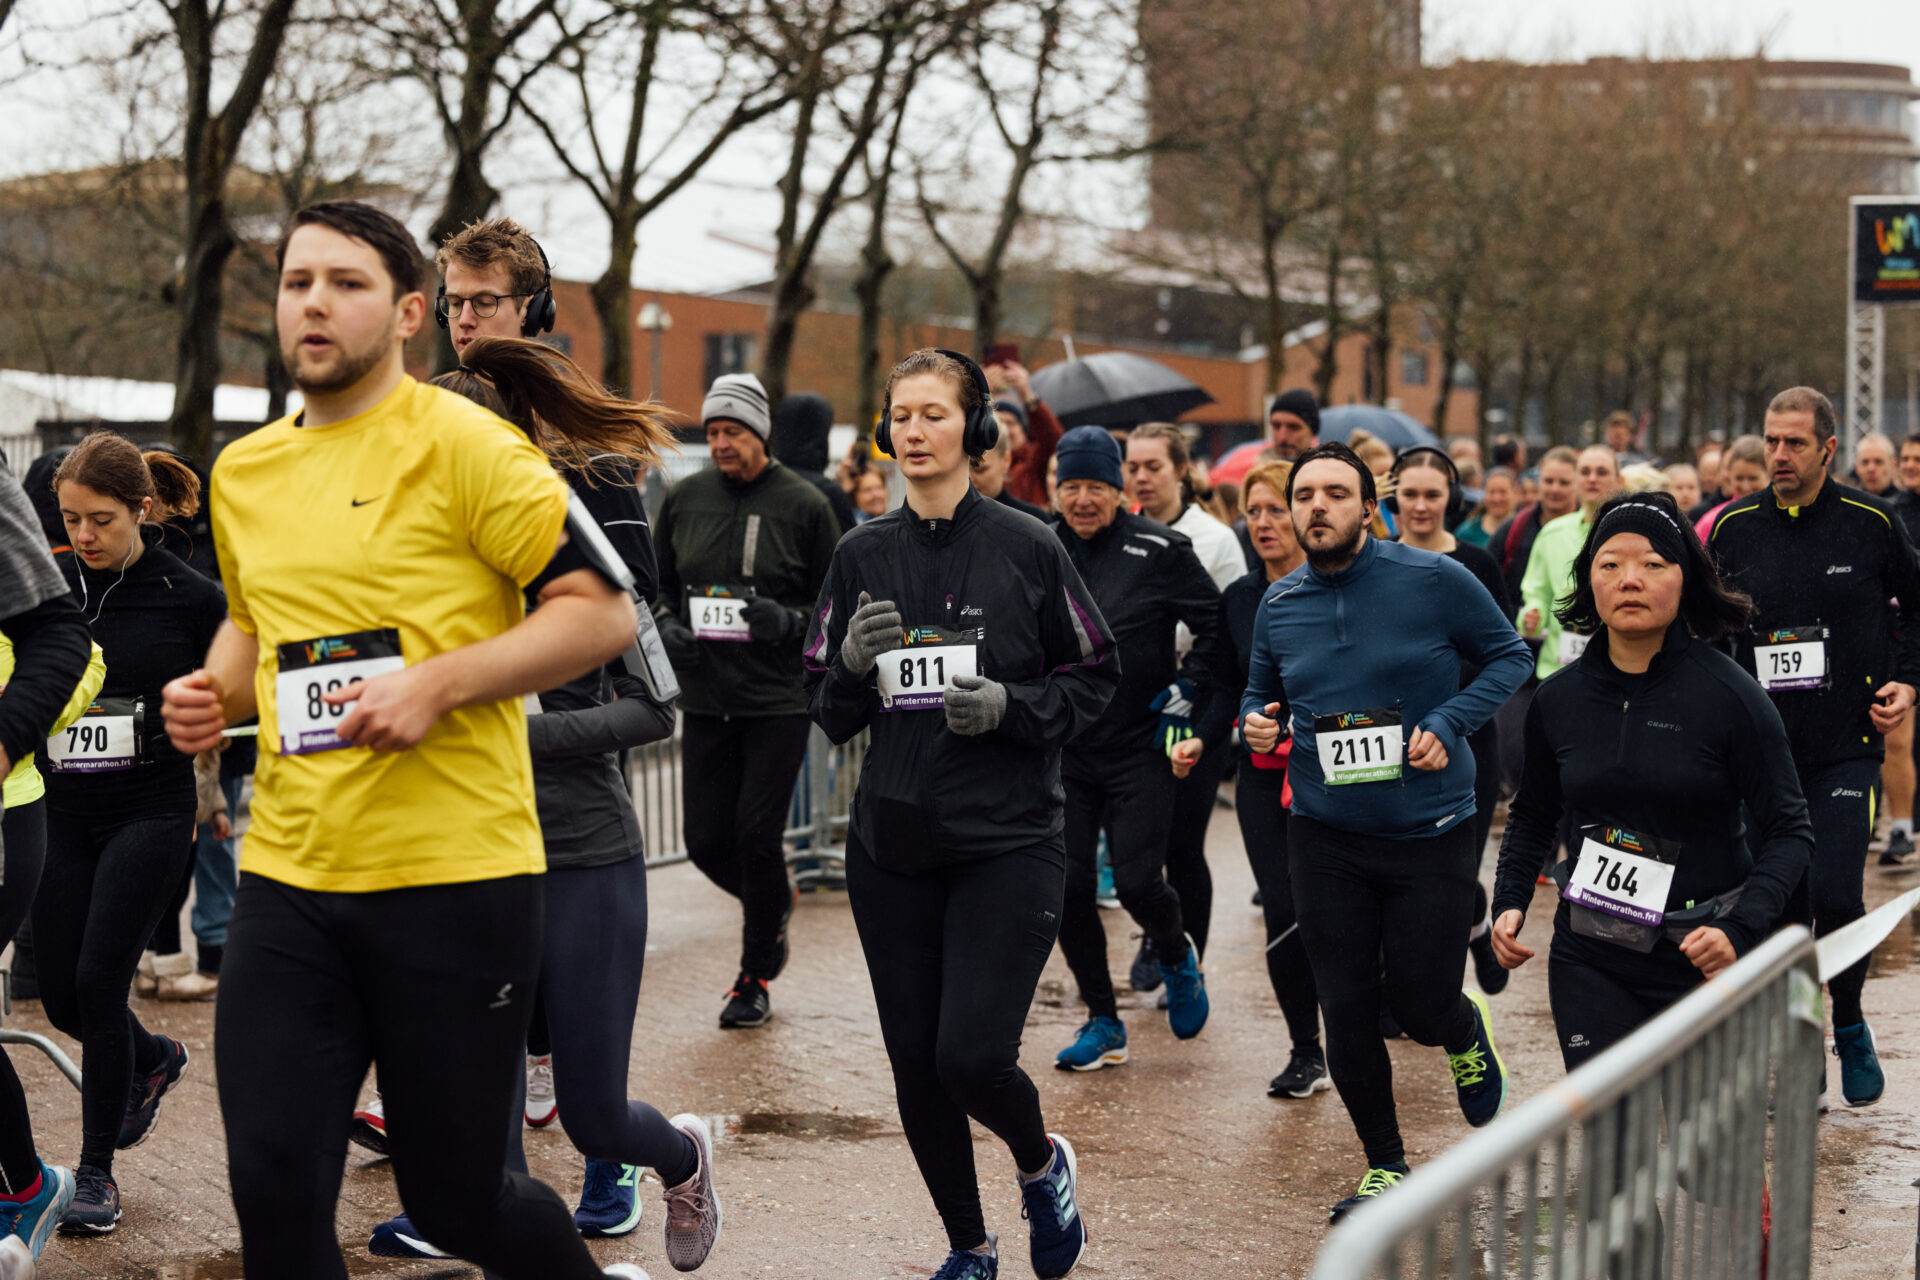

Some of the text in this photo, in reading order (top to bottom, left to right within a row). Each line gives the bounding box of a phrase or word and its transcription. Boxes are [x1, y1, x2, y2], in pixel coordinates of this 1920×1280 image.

[702, 606, 733, 625] 615
[899, 656, 945, 688] 811
[1770, 651, 1802, 675] 759
[307, 676, 364, 720] 88
[66, 725, 108, 753] 790
[1331, 735, 1386, 766] 2111
[63, 759, 131, 769] Wintermarathon.frl
[1593, 855, 1638, 898] 764
[1582, 892, 1657, 923] Wintermarathon.frl
